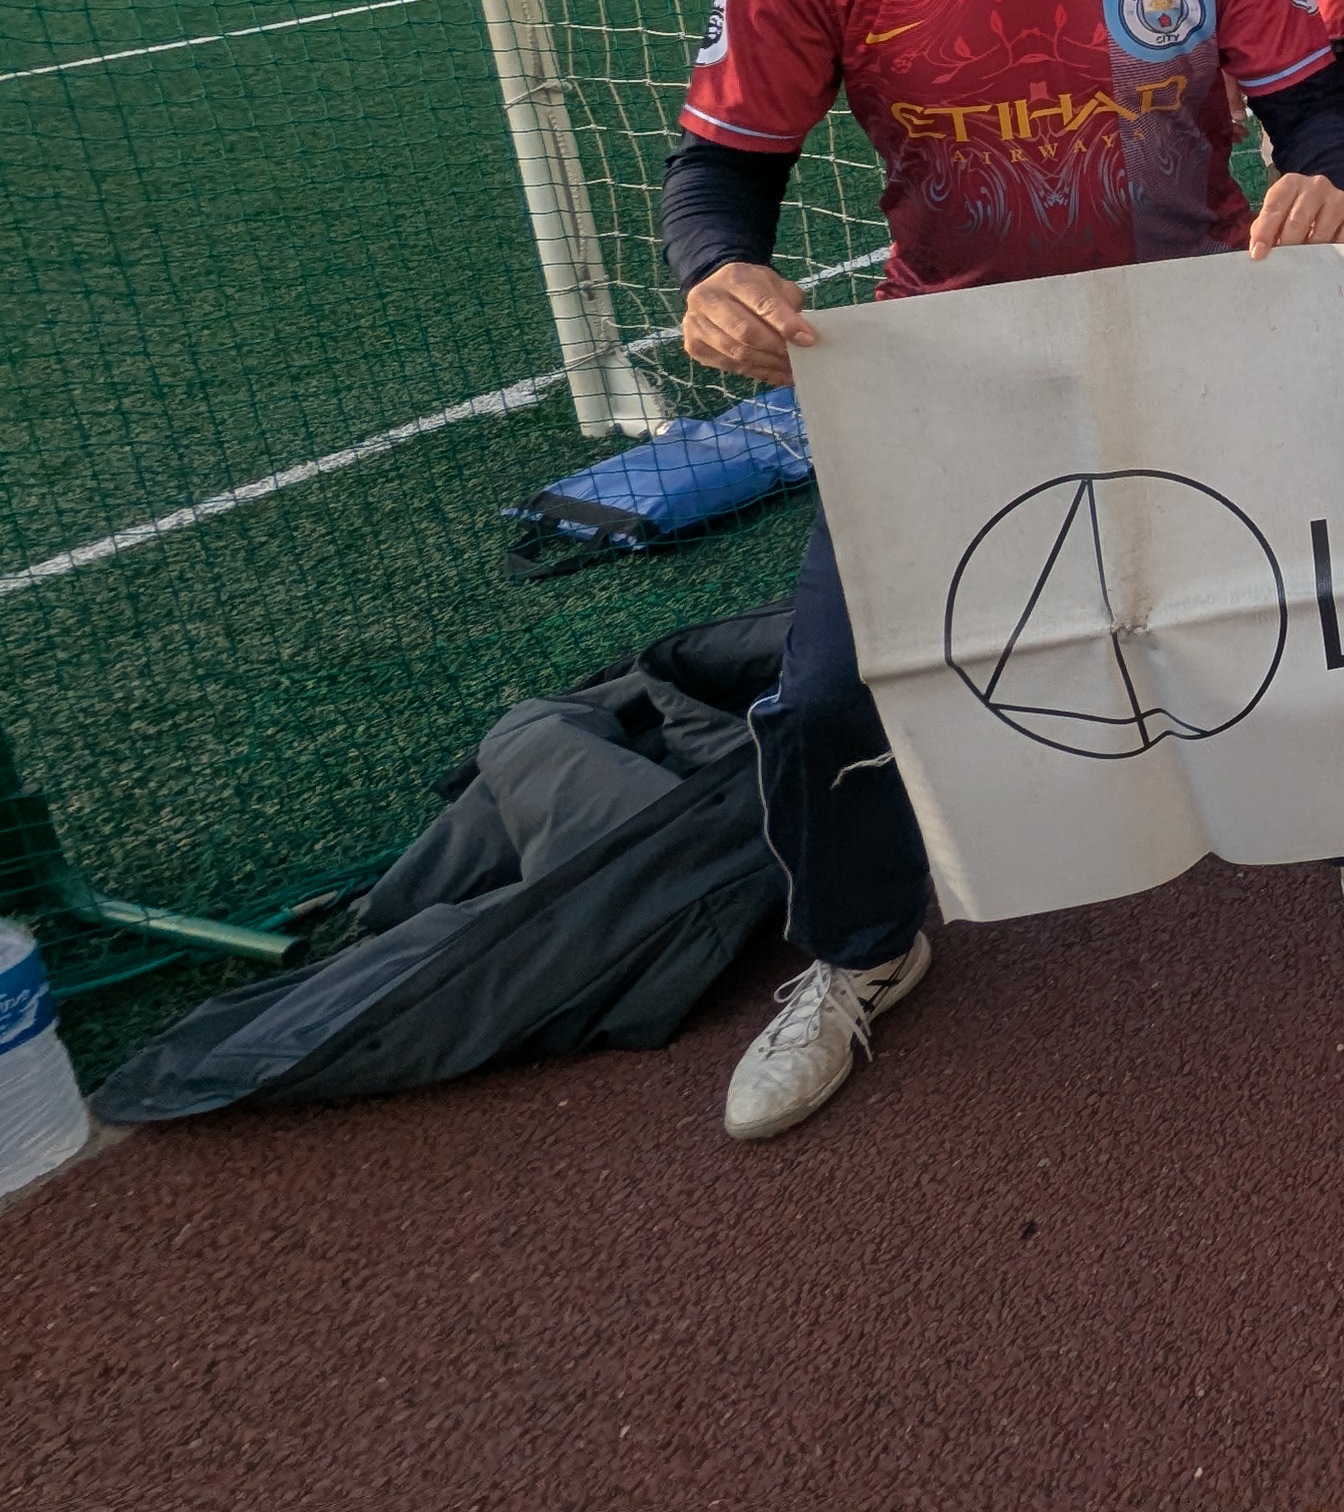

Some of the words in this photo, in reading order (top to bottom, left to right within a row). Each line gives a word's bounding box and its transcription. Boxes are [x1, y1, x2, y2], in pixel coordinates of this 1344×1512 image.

[1154, 33, 1180, 45] CITY
[890, 75, 1188, 142] ETIHAD
[952, 128, 1144, 165] AIRWAYS
